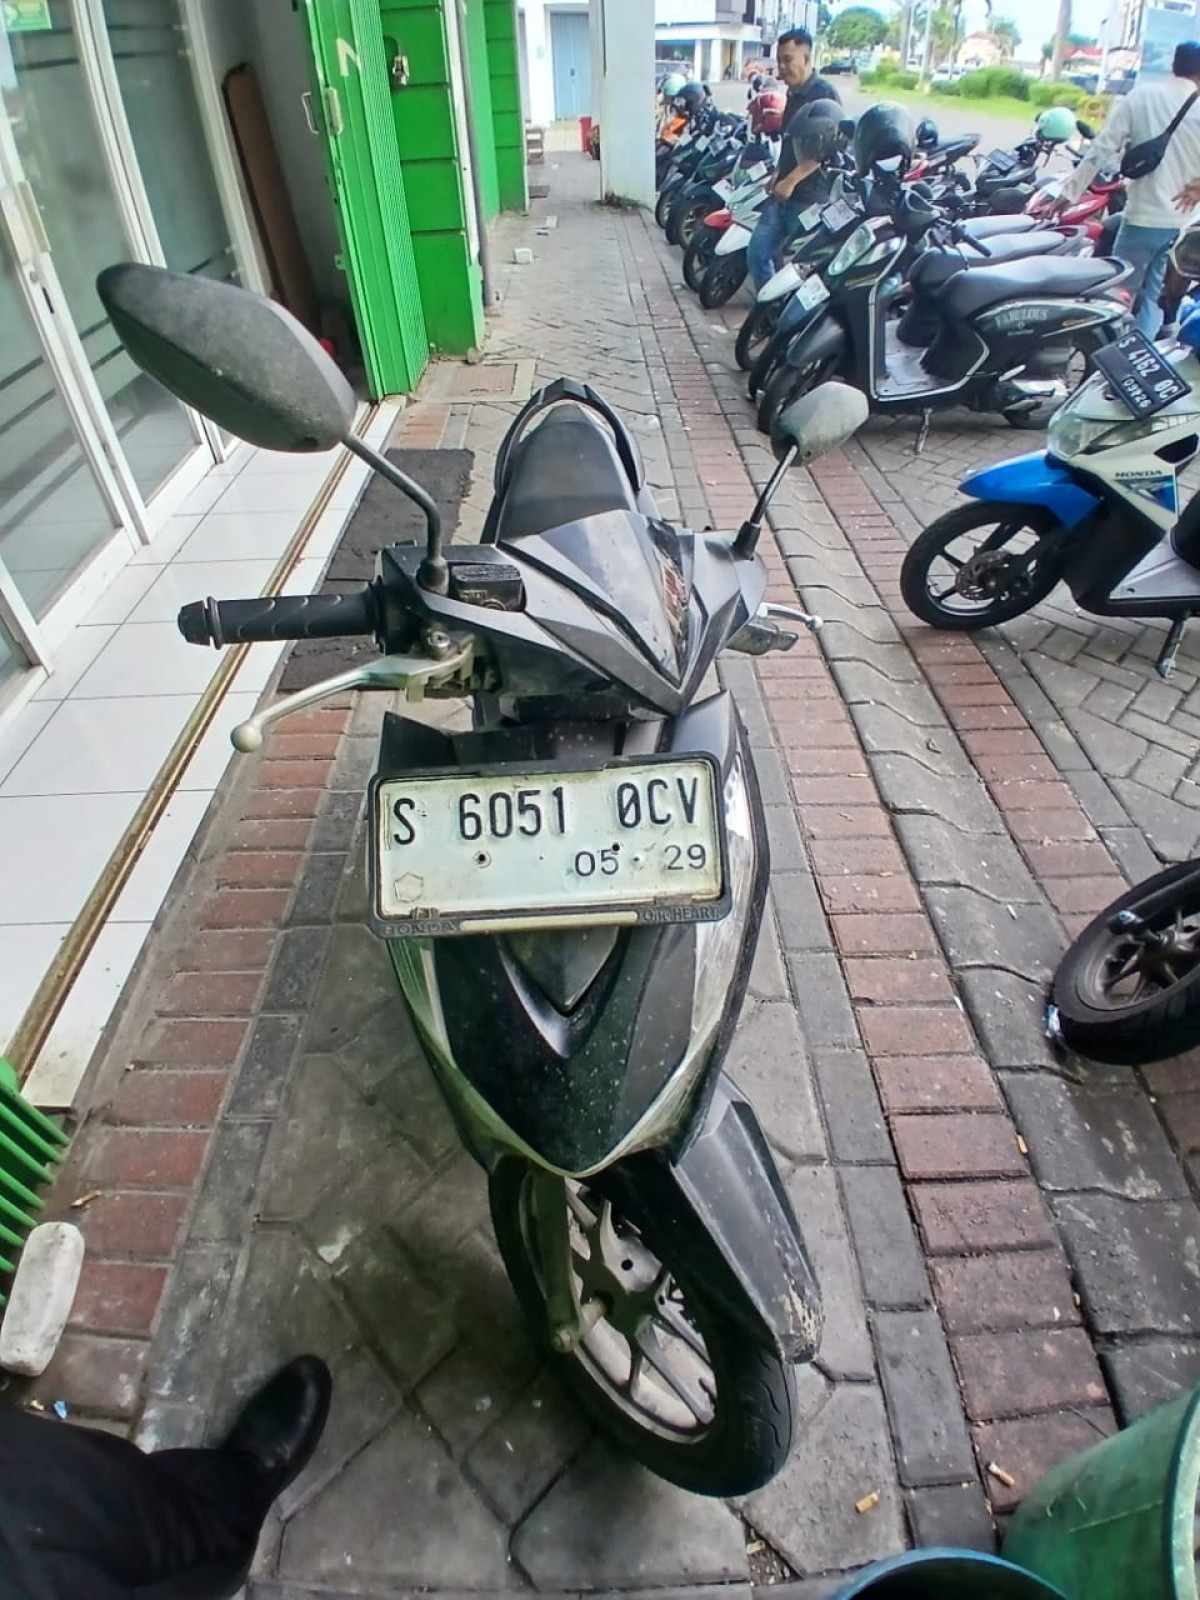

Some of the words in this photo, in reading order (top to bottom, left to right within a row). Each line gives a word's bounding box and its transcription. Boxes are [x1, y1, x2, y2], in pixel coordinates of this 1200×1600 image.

[1119, 336, 1136, 348] S
[1129, 350, 1160, 377] 4162
[1115, 470, 1162, 478] HONDA
[393, 797, 416, 846] S
[458, 786, 566, 841] 6051
[574, 849, 620, 877] 05
[664, 843, 707, 871] 29
